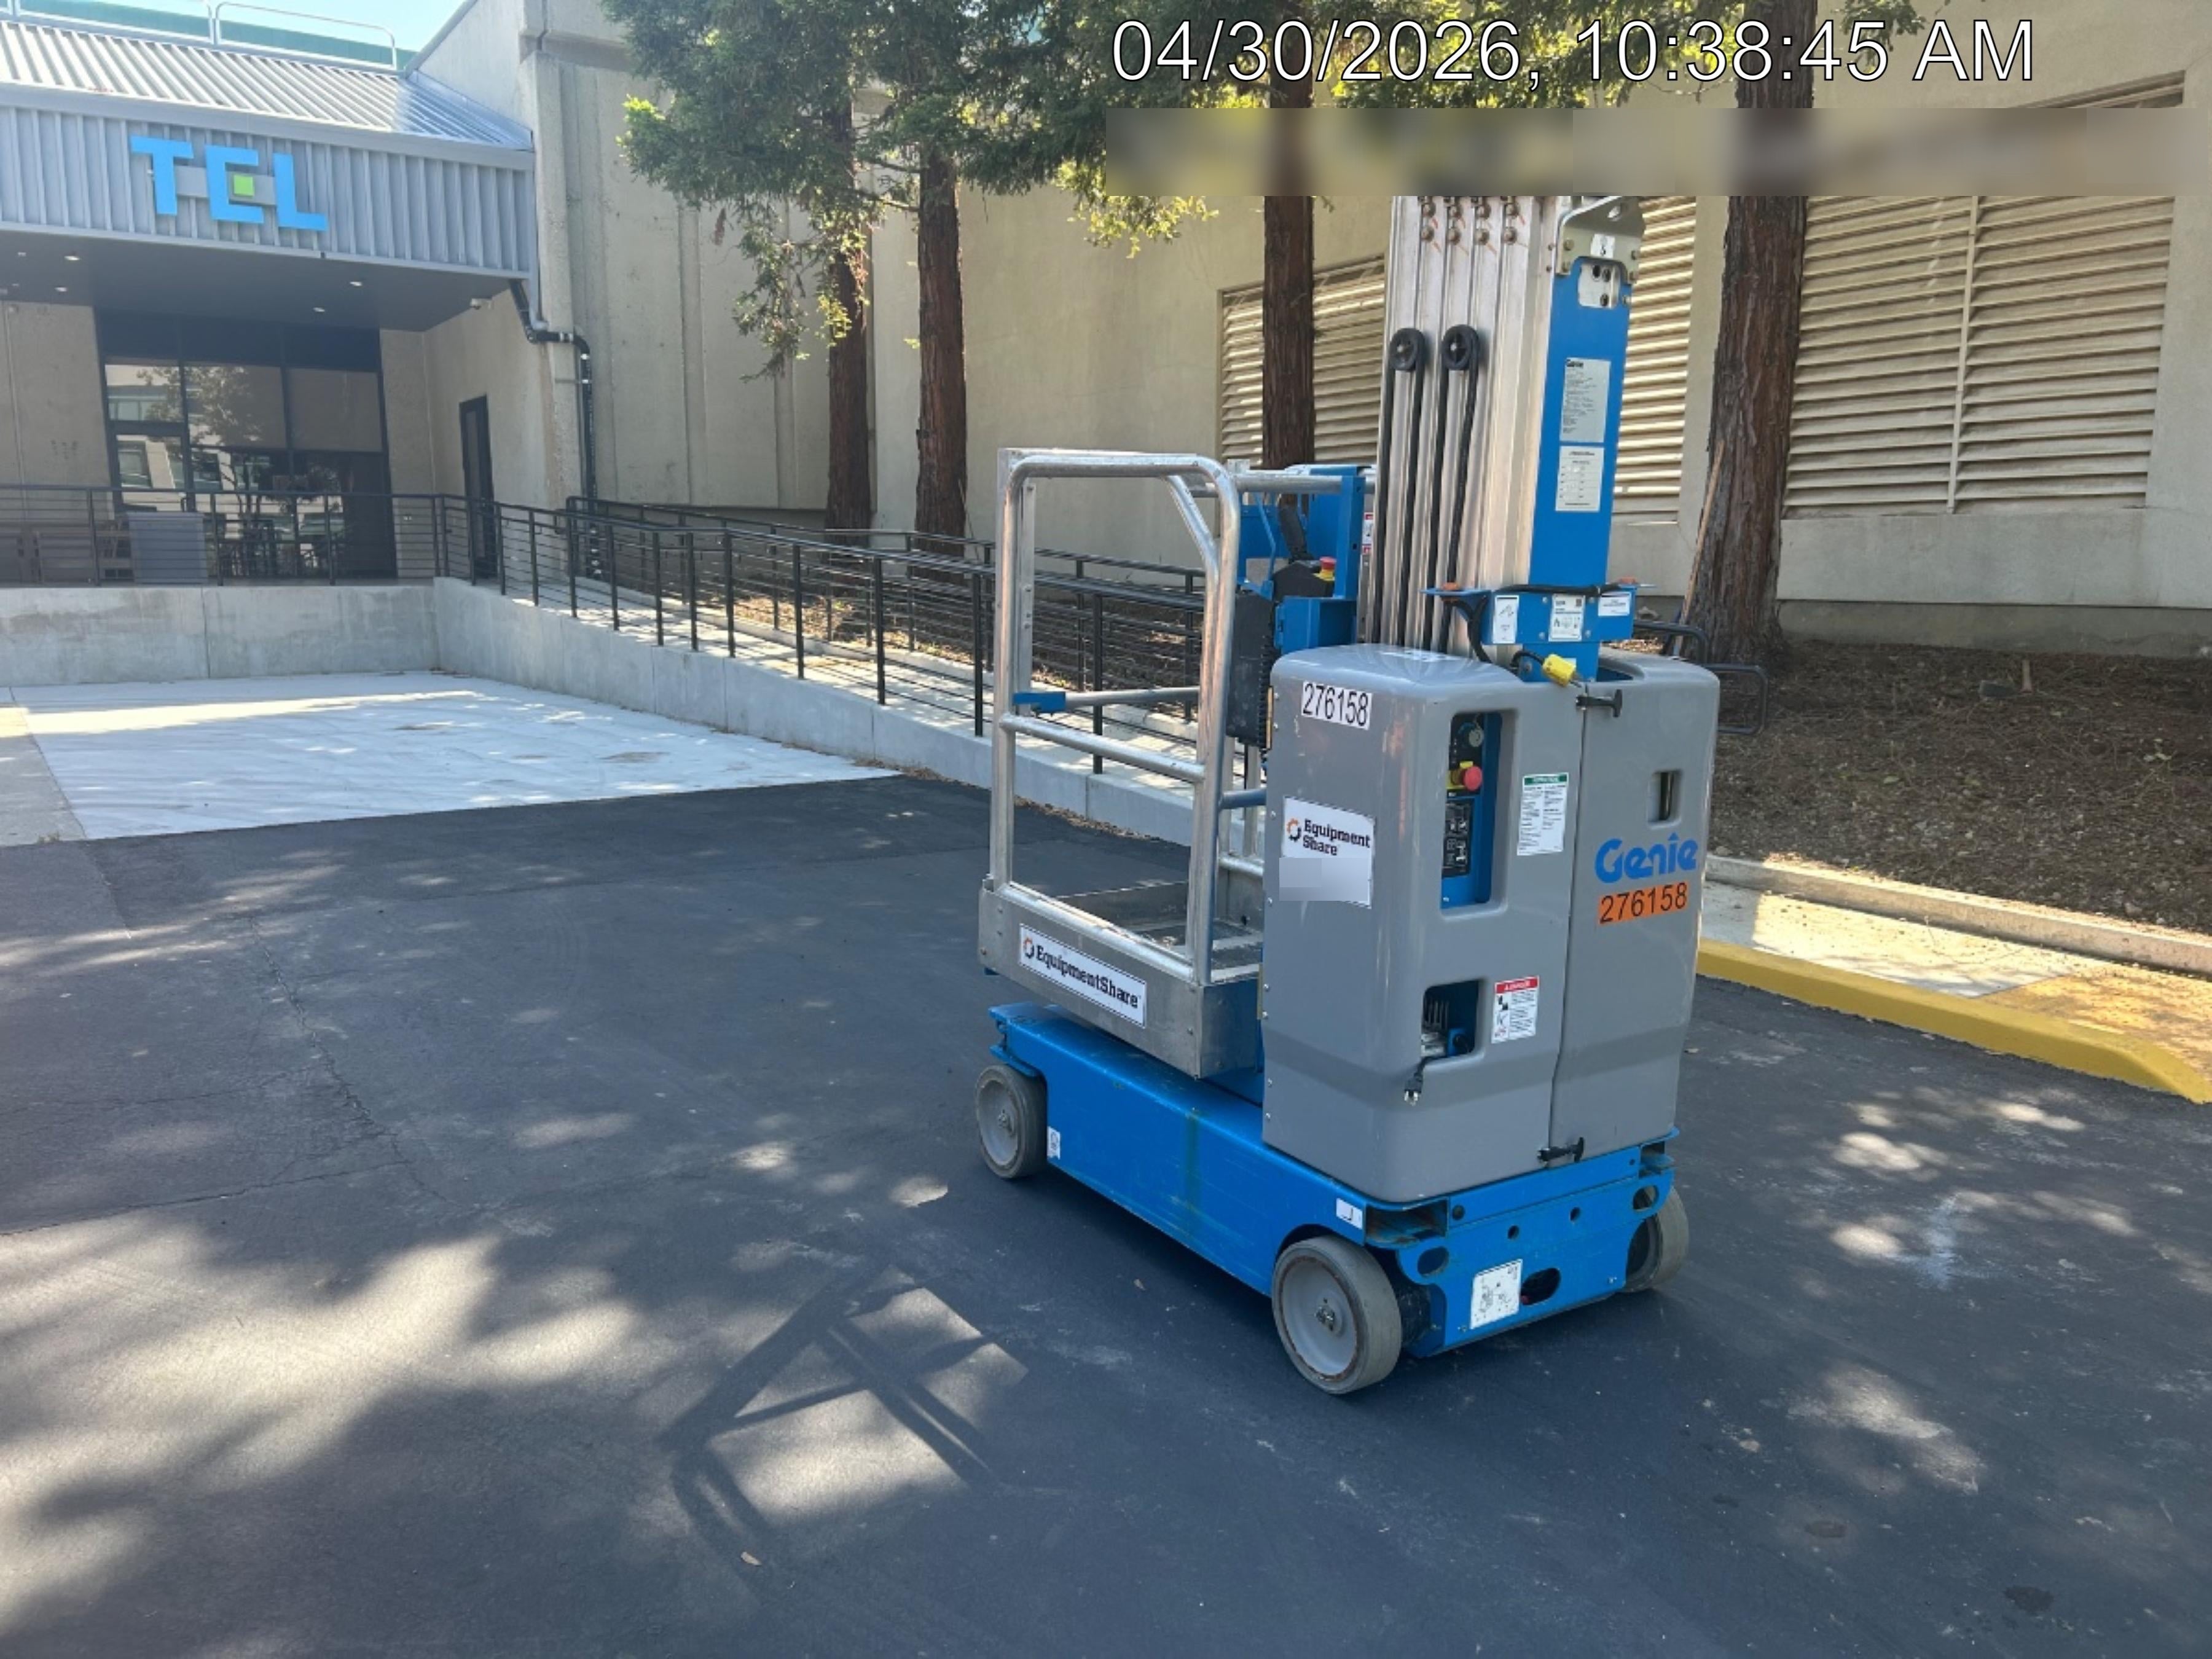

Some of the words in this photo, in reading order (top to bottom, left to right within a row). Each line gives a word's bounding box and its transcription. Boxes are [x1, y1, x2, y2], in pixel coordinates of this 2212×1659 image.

[130, 135, 329, 232] TEL
[1303, 683, 1368, 726] 276158
[1303, 835, 1338, 856] Share
[1304, 818, 1371, 849] Equipment
[1594, 832, 1698, 884] Genie
[1599, 882, 1687, 924] 276158
[1036, 944, 1138, 1008] EquipmentShare
